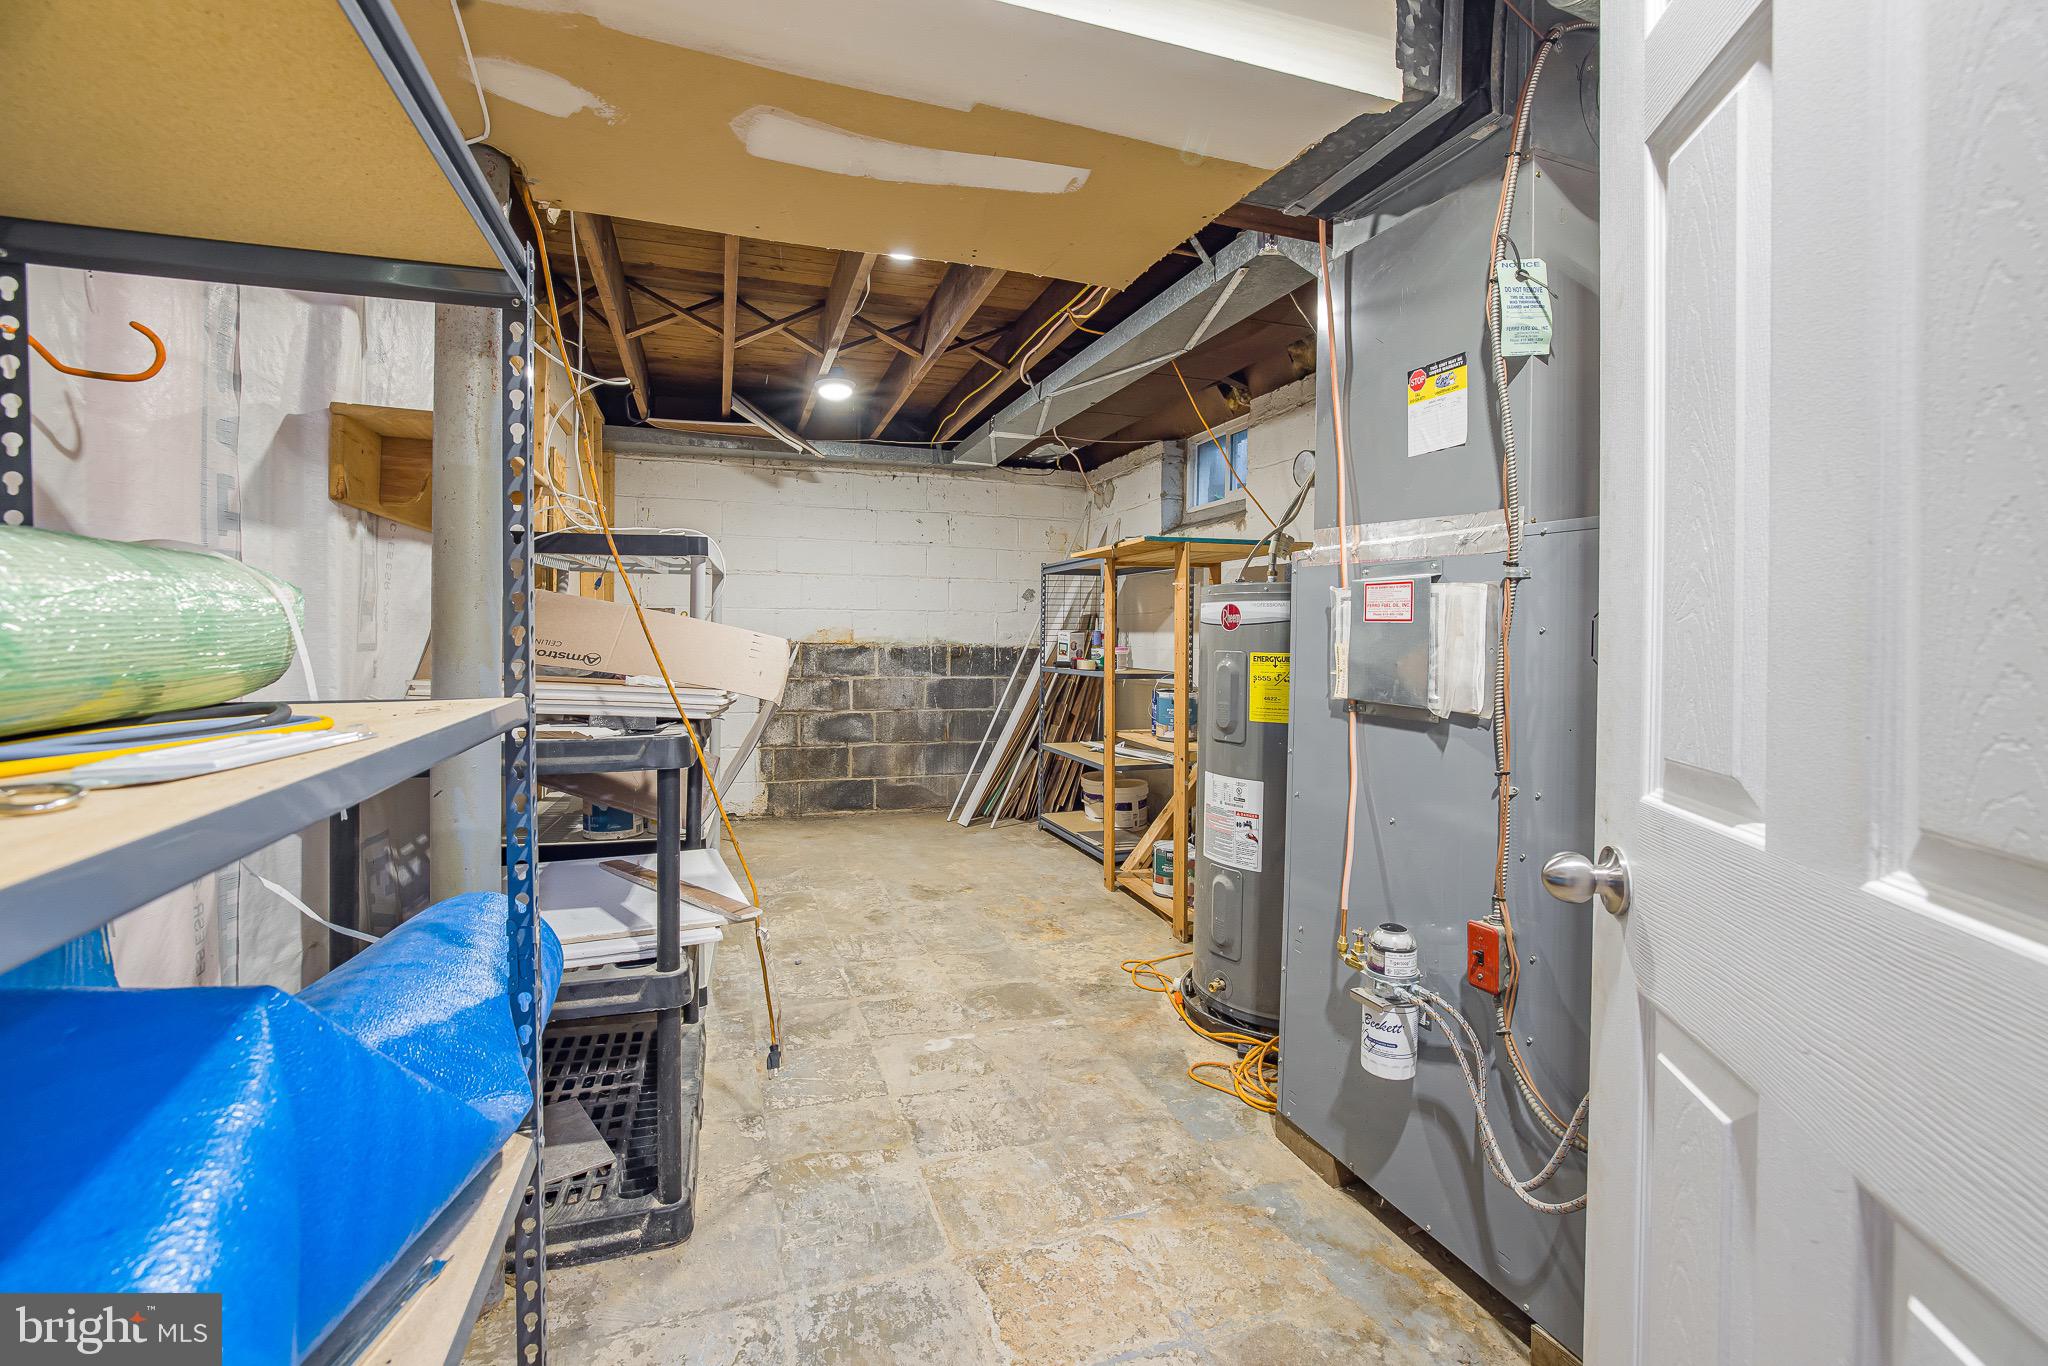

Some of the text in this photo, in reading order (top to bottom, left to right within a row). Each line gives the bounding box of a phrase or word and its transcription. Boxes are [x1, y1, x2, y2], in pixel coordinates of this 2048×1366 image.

[1410, 376, 1425, 386] STOP
[1221, 603, 1241, 628] Rheem
[1364, 1013, 1402, 1034] Beckett
